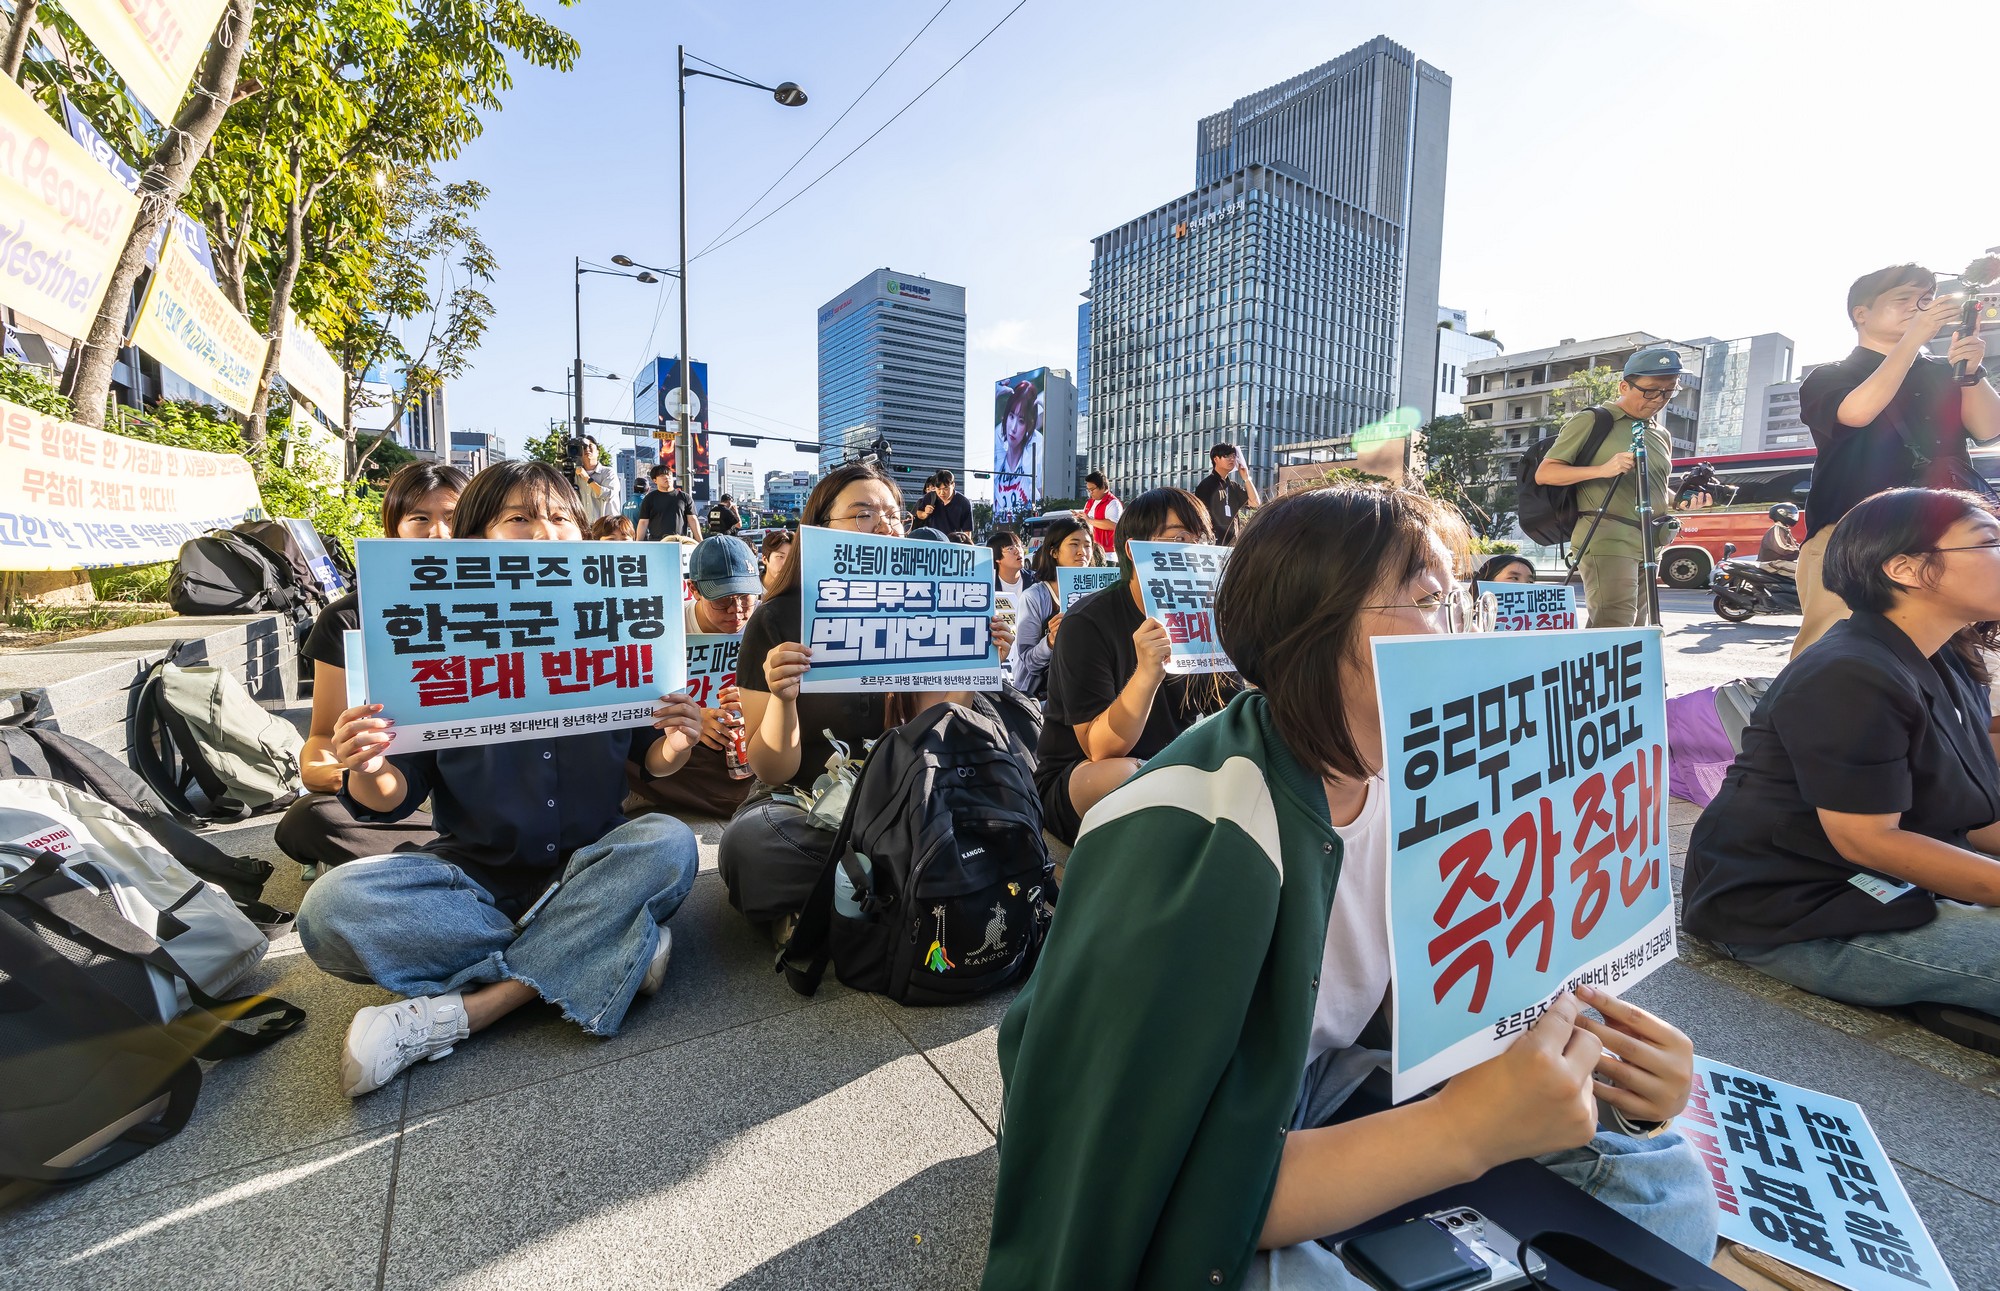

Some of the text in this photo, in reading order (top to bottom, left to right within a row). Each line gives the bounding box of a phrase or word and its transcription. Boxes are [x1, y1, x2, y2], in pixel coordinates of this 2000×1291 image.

[22, 136, 124, 246] People!
[1189, 199, 1246, 232] 현대해상화재
[41, 422, 97, 466] 힘없는
[103, 438, 119, 469] 한
[122, 444, 164, 476] 가정과
[166, 451, 179, 477] 한
[22, 468, 178, 513] 무참히 짓밟고 있다!!
[73, 520, 141, 551] 가정을
[410, 555, 573, 591] 호르무즈
[582, 554, 648, 588] 해협
[833, 543, 975, 577] 청년들이 방패막이인가?!
[1151, 551, 1217, 573] 호르무즈
[817, 578, 989, 609] 호르무즈 파병
[1073, 574, 1098, 590] 청년들이
[1148, 578, 1216, 610] 한국군
[1526, 588, 1566, 613] 파병검토
[382, 596, 665, 655] 한국군 파병
[811, 616, 990, 664] 반대한다
[1164, 611, 1212, 644] 절대
[410, 652, 526, 707] 절대
[540, 643, 654, 696] 반대!
[860, 675, 999, 686] 호르무즈 파병 절대반대 청년학생 긴급집회
[1176, 659, 1197, 668] 호르무즈
[422, 706, 654, 743] 호르무즈 파병 절대반대 청년학생 긴급집회
[1398, 640, 1644, 851] 호르무즈 파병검토
[961, 846, 986, 860] KANGOL
[1428, 743, 1663, 1014] 즉각 중단!
[964, 950, 1011, 966] KANGOL
[1610, 944, 1645, 982] 청년학생
[1645, 925, 1672, 962] 긴급집회
[1708, 1070, 1845, 1268] 한국군 파병
[1796, 1103, 1932, 1289] 호르무즈 해협
